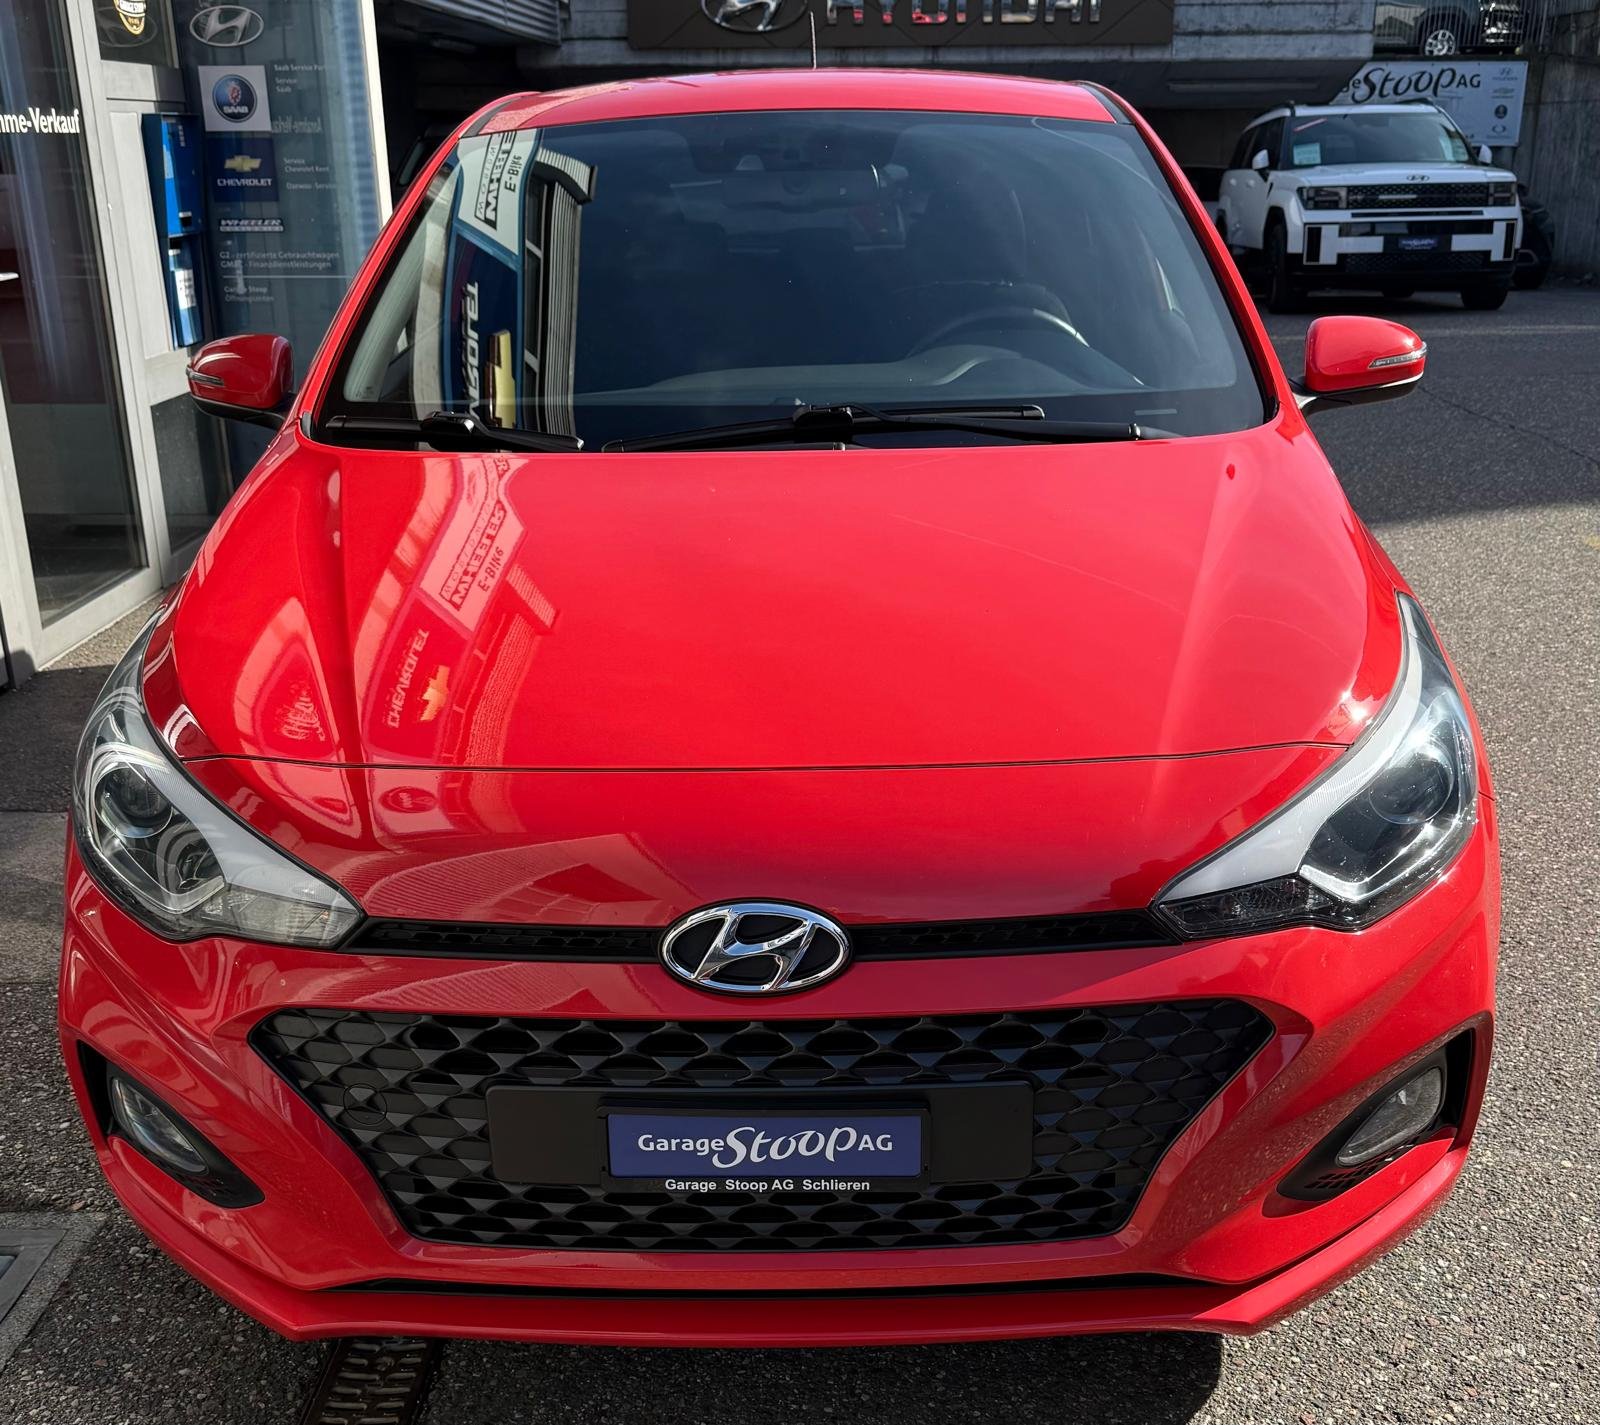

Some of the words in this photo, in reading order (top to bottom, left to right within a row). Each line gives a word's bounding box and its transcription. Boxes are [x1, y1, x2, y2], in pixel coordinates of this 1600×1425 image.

[1351, 67, 1457, 104] Stoop
[1456, 74, 1481, 89] AG
[223, 105, 249, 114] SAAB
[216, 178, 273, 187] CHEVROLET
[638, 1134, 725, 1156] Garage
[711, 1126, 858, 1169] Stoop
[858, 1134, 893, 1151] AG
[665, 1179, 717, 1194] Garage
[725, 1179, 768, 1194] Stoop
[771, 1179, 794, 1191] AG
[802, 1178, 870, 1191] Schlieren
